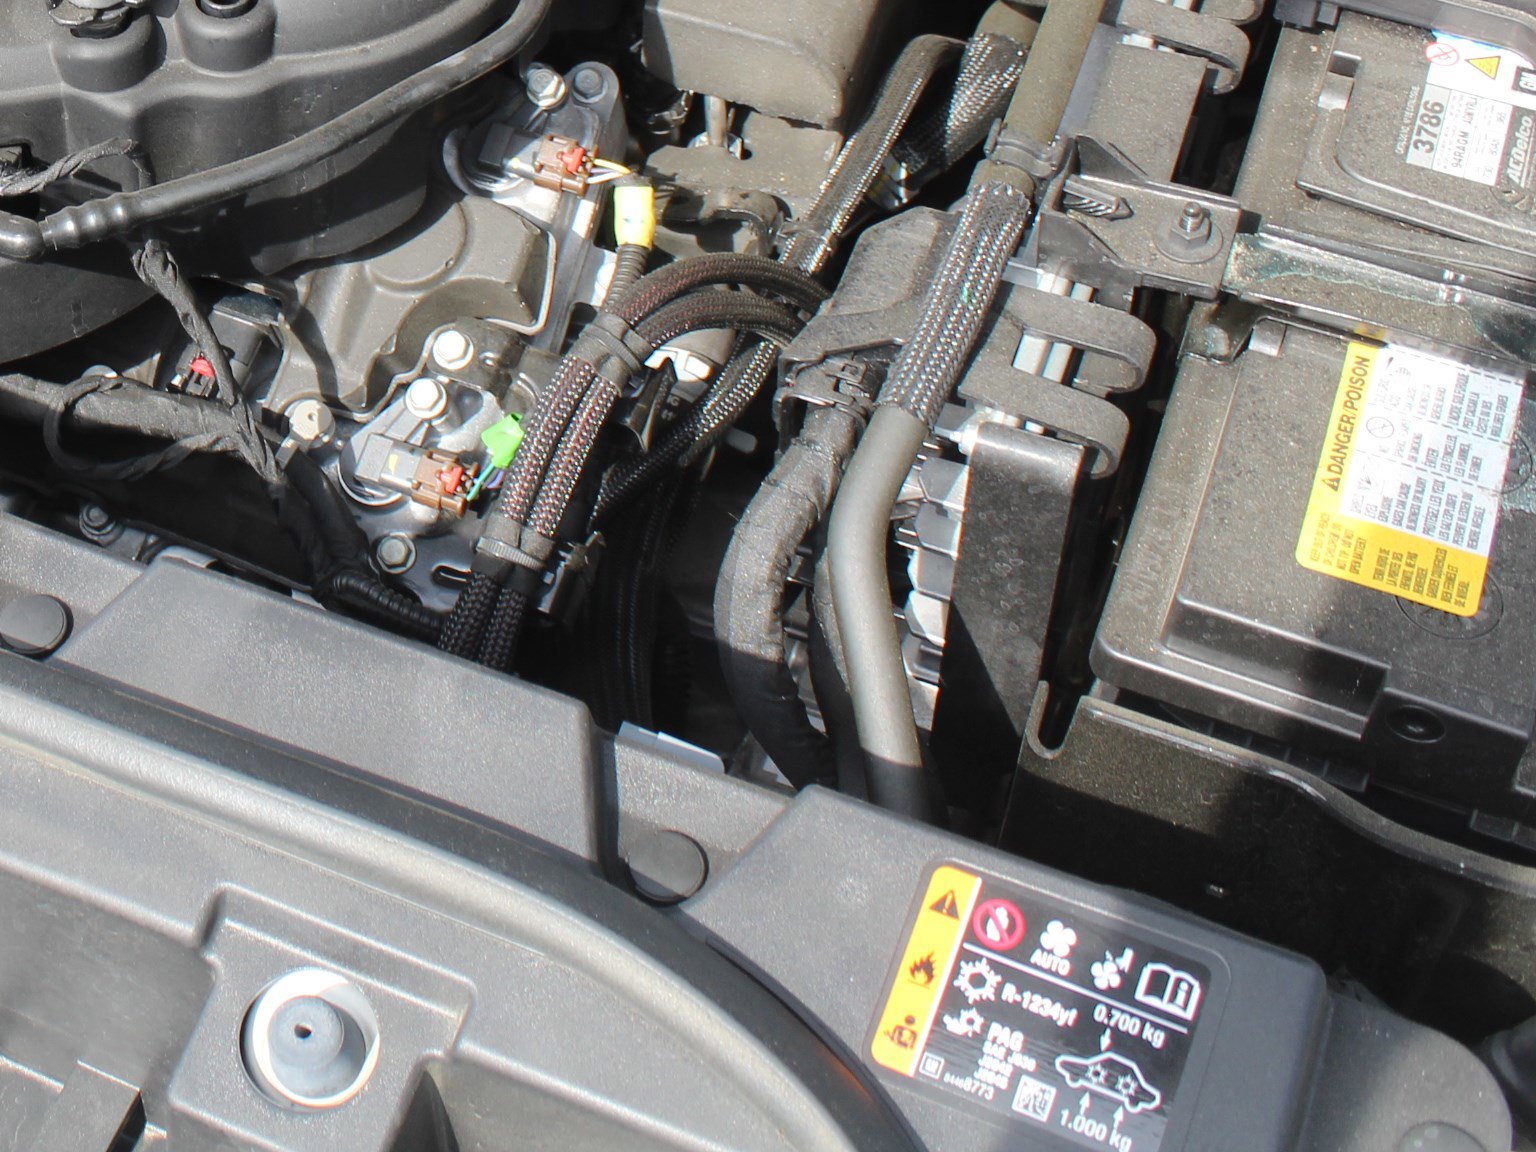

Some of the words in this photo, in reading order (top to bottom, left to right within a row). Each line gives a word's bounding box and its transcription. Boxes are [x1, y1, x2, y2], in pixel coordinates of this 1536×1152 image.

[1412, 100, 1445, 154] 3786
[1506, 115, 1533, 184] ACDelco
[1327, 355, 1370, 476] DANGER/POISON
[1428, 494, 1442, 507] LES
[1430, 478, 1445, 494] YEUX
[1437, 530, 1449, 541] LES
[1030, 948, 1071, 976] AUTO
[1001, 982, 1078, 1027] R-1234yf
[1093, 1003, 1141, 1036] 0.700
[1142, 1021, 1166, 1048] kg
[987, 1021, 1024, 1052] PAG
[1060, 1109, 1107, 1141] 1.000
[1109, 1129, 1132, 1152] kg
